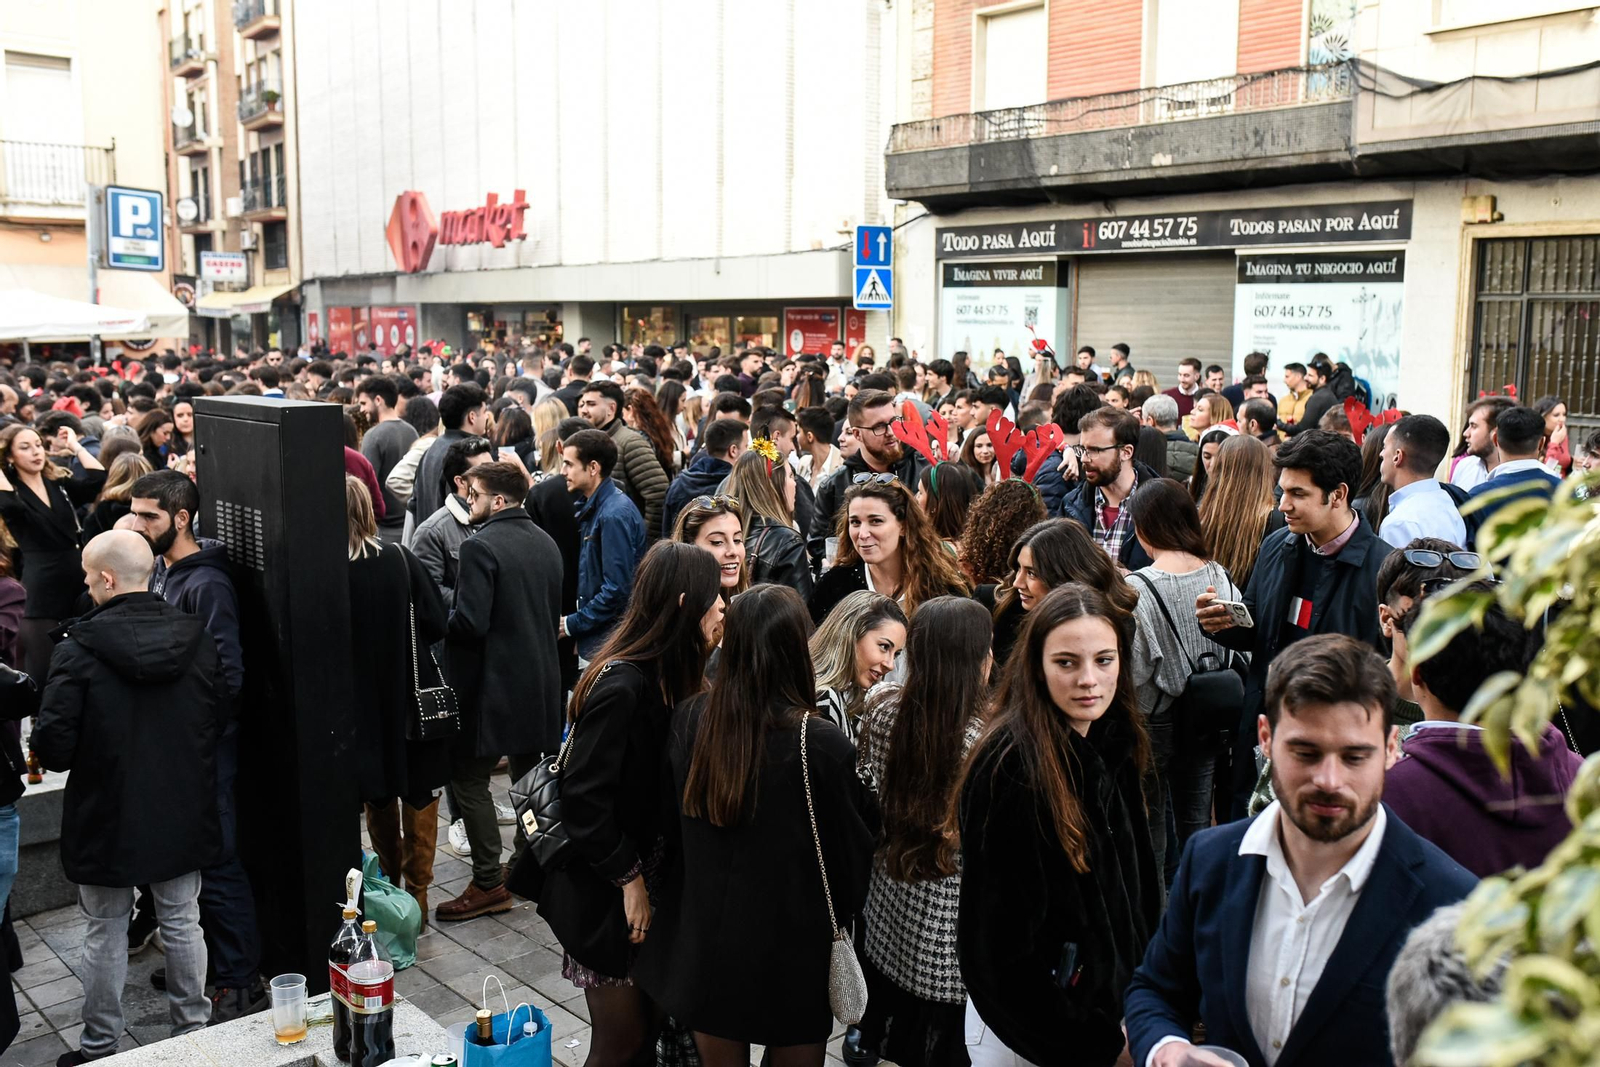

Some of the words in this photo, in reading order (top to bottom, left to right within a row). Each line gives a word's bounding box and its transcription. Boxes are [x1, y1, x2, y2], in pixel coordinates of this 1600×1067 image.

[118, 194, 151, 237] P
[440, 190, 529, 247] market
[1230, 219, 1275, 236] TODOS
[1277, 219, 1322, 234] PASAN
[1325, 216, 1354, 232] POR
[1358, 208, 1400, 231] AQUÍ
[942, 232, 980, 252] TODO
[982, 233, 1015, 250] PASA
[1018, 223, 1056, 248] AQUÍ
[1098, 220, 1128, 240] 607
[1129, 219, 1151, 239] 44
[1152, 217, 1174, 238] 57
[1176, 216, 1198, 237] 75
[953, 267, 991, 281] IMAGINA
[993, 268, 1018, 281] VIVIR
[1020, 265, 1044, 280] AQUÍ
[1245, 262, 1292, 276] IMAGINA
[1295, 264, 1312, 275] TU
[1314, 262, 1364, 275] NEGOCIO
[1366, 257, 1397, 274] AQUÍ
[956, 305, 972, 316] 607
[973, 305, 984, 316] 44
[985, 305, 997, 316] 57
[998, 305, 1009, 316] 75
[1254, 305, 1277, 318] 607
[1279, 305, 1295, 318] 44
[1298, 305, 1314, 318] 57
[1317, 305, 1333, 318] 75
